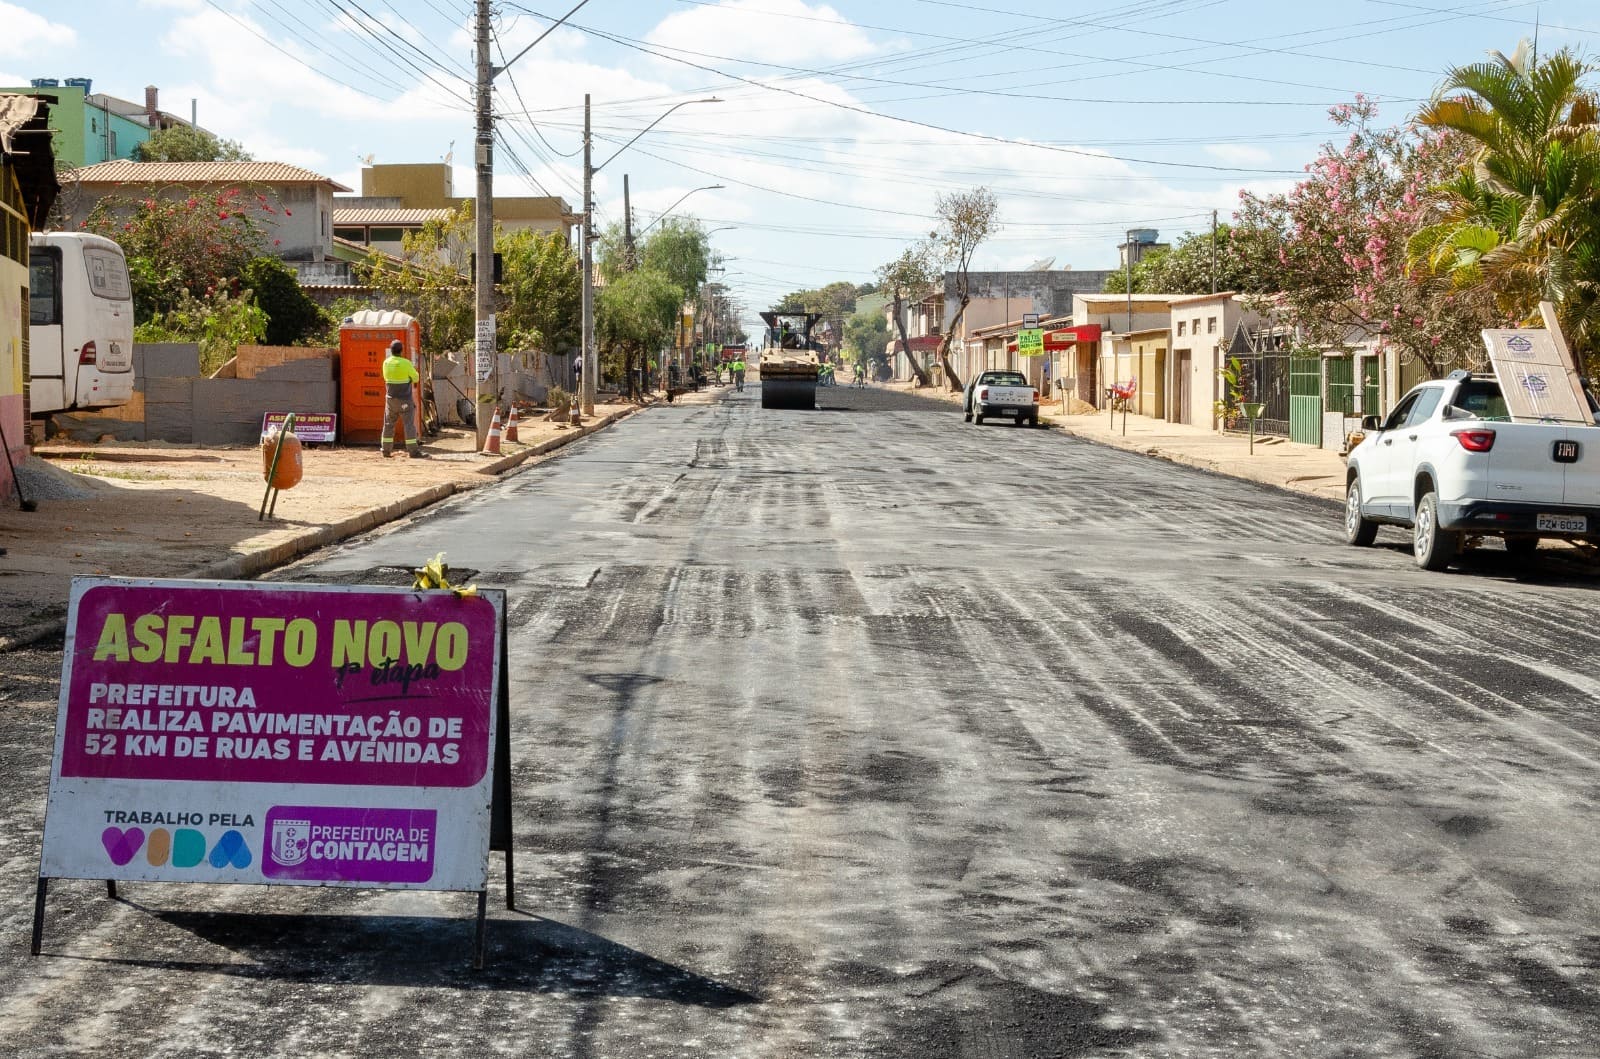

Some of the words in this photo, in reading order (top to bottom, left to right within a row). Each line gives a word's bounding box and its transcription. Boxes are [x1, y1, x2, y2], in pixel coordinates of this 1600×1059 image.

[1558, 443, 1576, 457] FIAT
[93, 613, 317, 667] ASFALTO
[331, 619, 468, 671] NOVO
[370, 656, 440, 695] etapa
[89, 683, 256, 708] PREFEITURA
[87, 708, 203, 732] REALIZA
[211, 710, 421, 741] PAVIMENTAÇÃO
[428, 717, 463, 739] DE
[85, 734, 117, 755] 52
[124, 735, 167, 756] KM
[174, 736, 209, 758] DE
[215, 737, 291, 760] RUAS
[298, 739, 315, 761] E
[320, 740, 460, 765] AVENIDAS
[104, 810, 204, 826] TRABALHO
[208, 813, 255, 827] PELA
[311, 825, 405, 842] PREFEITURA
[409, 828, 430, 842] DE
[310, 840, 428, 862] CONTAGEM
